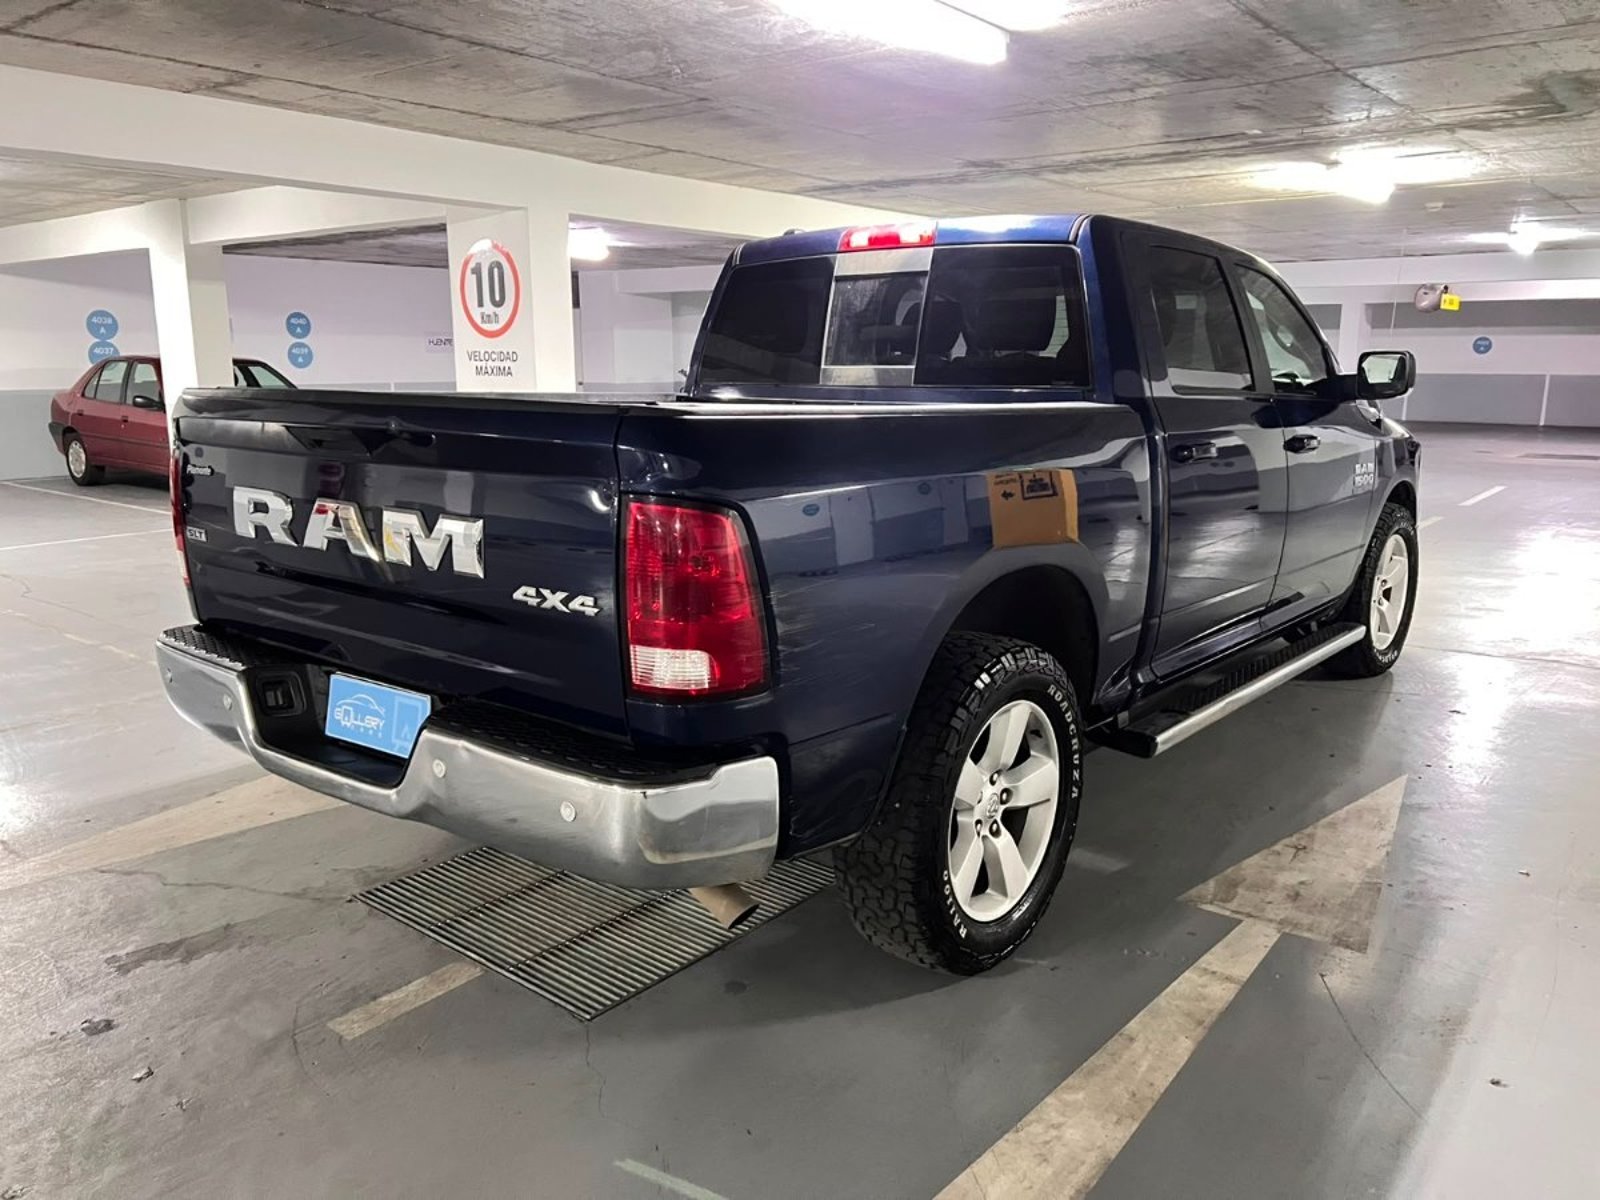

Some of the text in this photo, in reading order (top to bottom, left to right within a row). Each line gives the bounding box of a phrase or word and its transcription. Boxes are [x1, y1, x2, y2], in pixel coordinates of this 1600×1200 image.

[470, 259, 506, 309] 10
[467, 350, 518, 363] VELOCIDAD
[475, 363, 513, 377] MÁXIMA
[187, 528, 205, 541] SLT
[233, 485, 485, 579] RAM
[1047, 684, 1080, 799] ROADCRUZA
